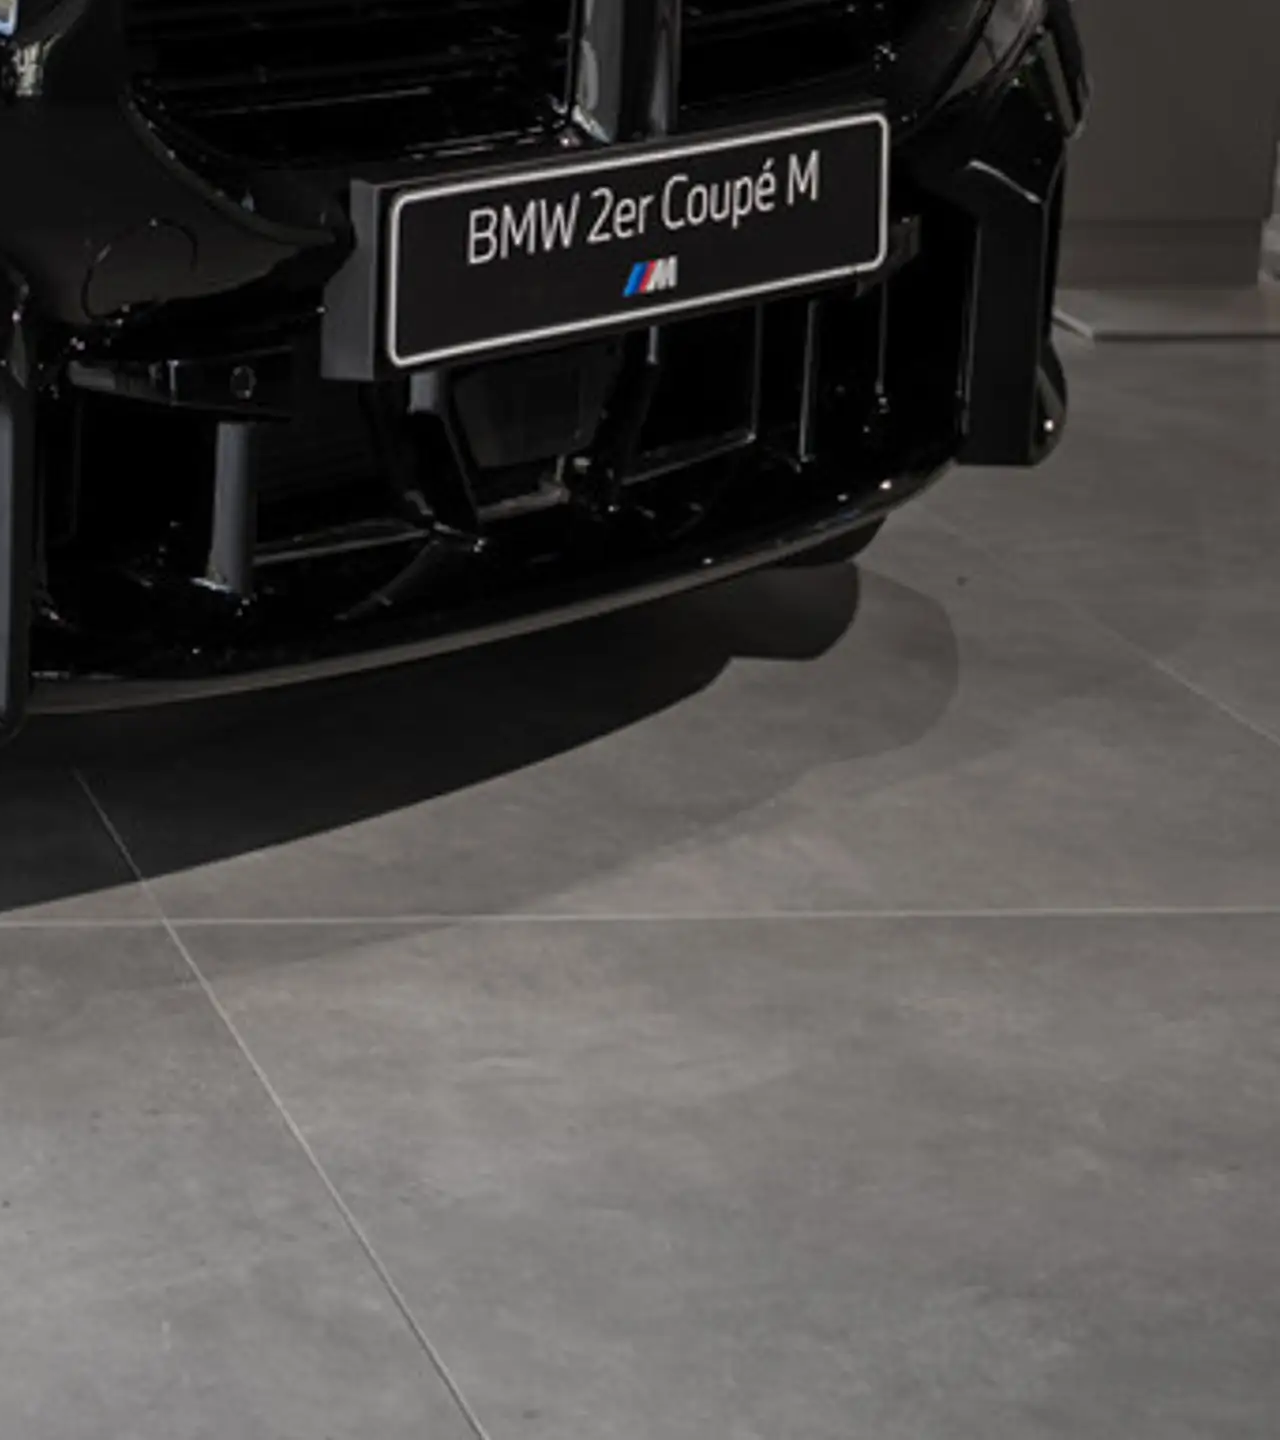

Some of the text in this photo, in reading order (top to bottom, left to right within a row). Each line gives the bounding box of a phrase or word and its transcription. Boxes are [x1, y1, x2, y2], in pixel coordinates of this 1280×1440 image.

[468, 149, 819, 265] BMW 2er Coupé M
